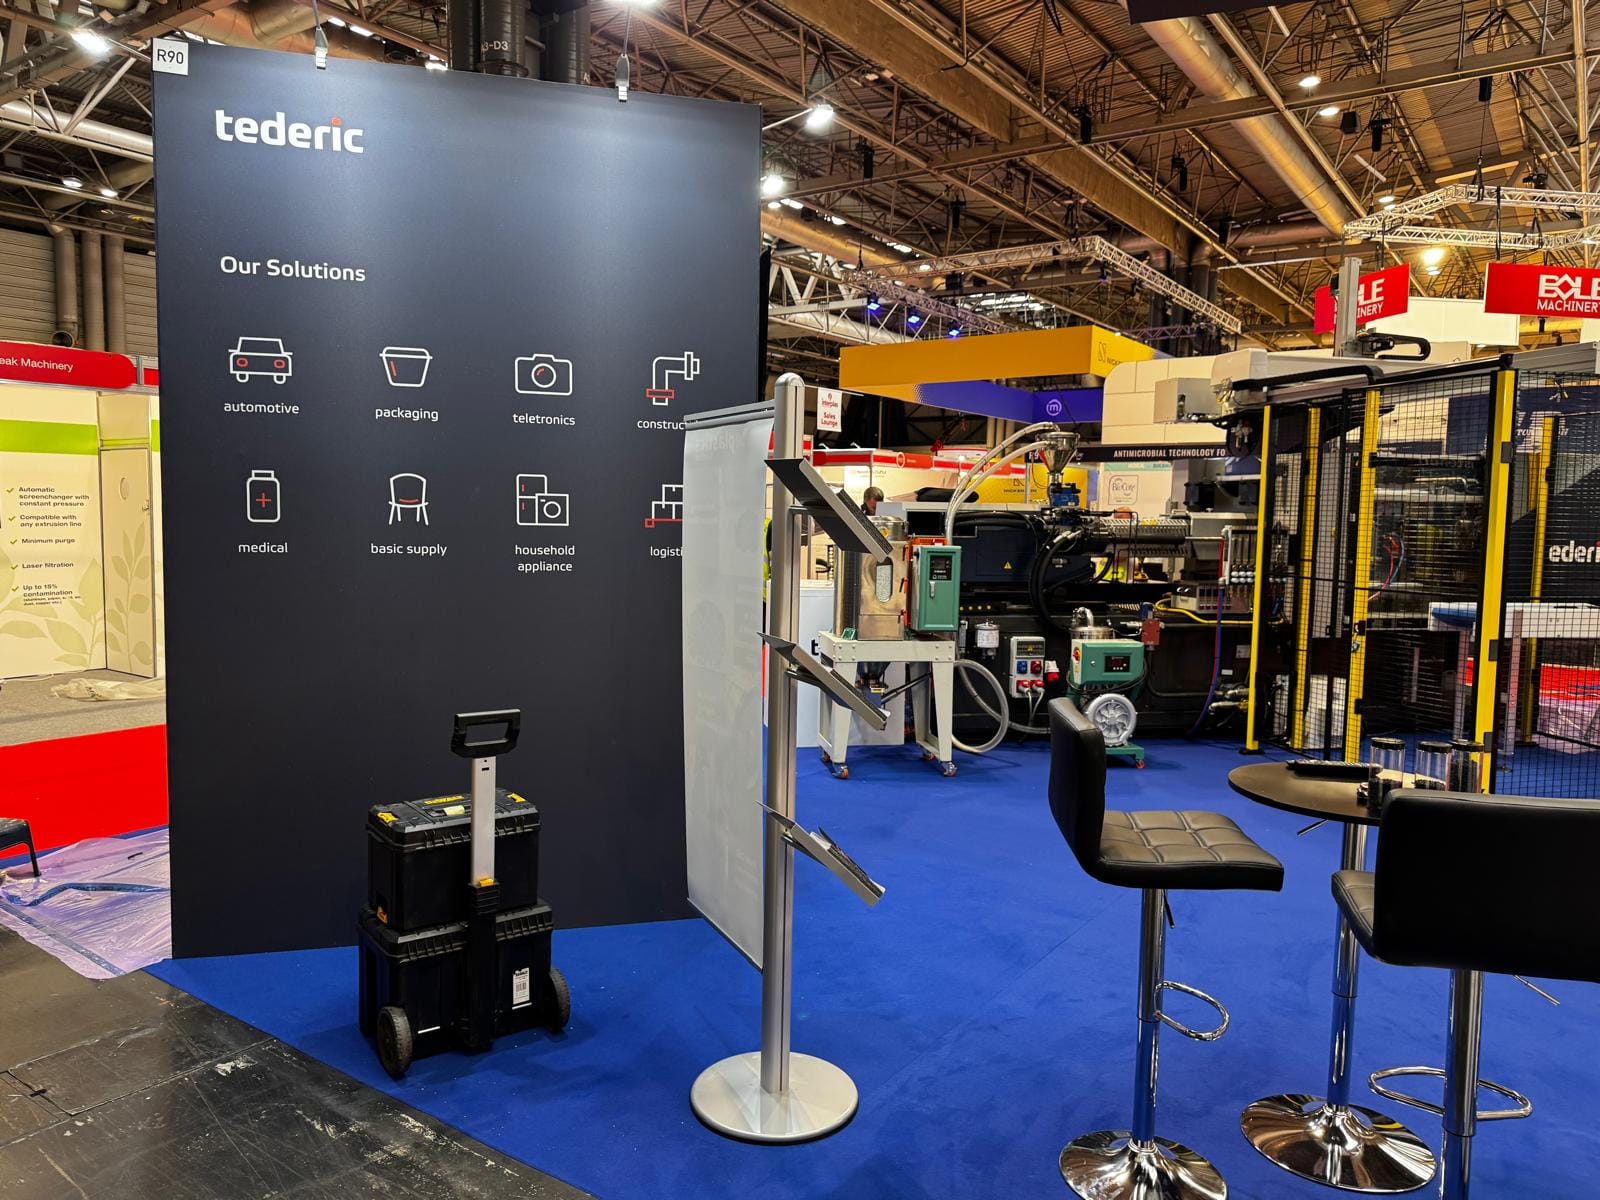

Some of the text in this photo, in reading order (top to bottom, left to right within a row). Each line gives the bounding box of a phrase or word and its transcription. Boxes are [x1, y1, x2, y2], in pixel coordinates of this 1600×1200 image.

[157, 48, 185, 65] R90
[215, 109, 364, 153] tederic
[220, 255, 366, 281] Our Solutions
[20, 357, 73, 373] Machinery
[224, 402, 300, 414] automotive
[375, 407, 439, 421] packaging
[512, 413, 576, 425] teletronics
[1113, 449, 1167, 458] ANTIMICROBIAL
[1168, 448, 1215, 457] TECHNOLOGY
[238, 542, 288, 553] medical
[370, 543, 447, 557] basic supply
[514, 545, 575, 556] household
[517, 561, 573, 573] appliance
